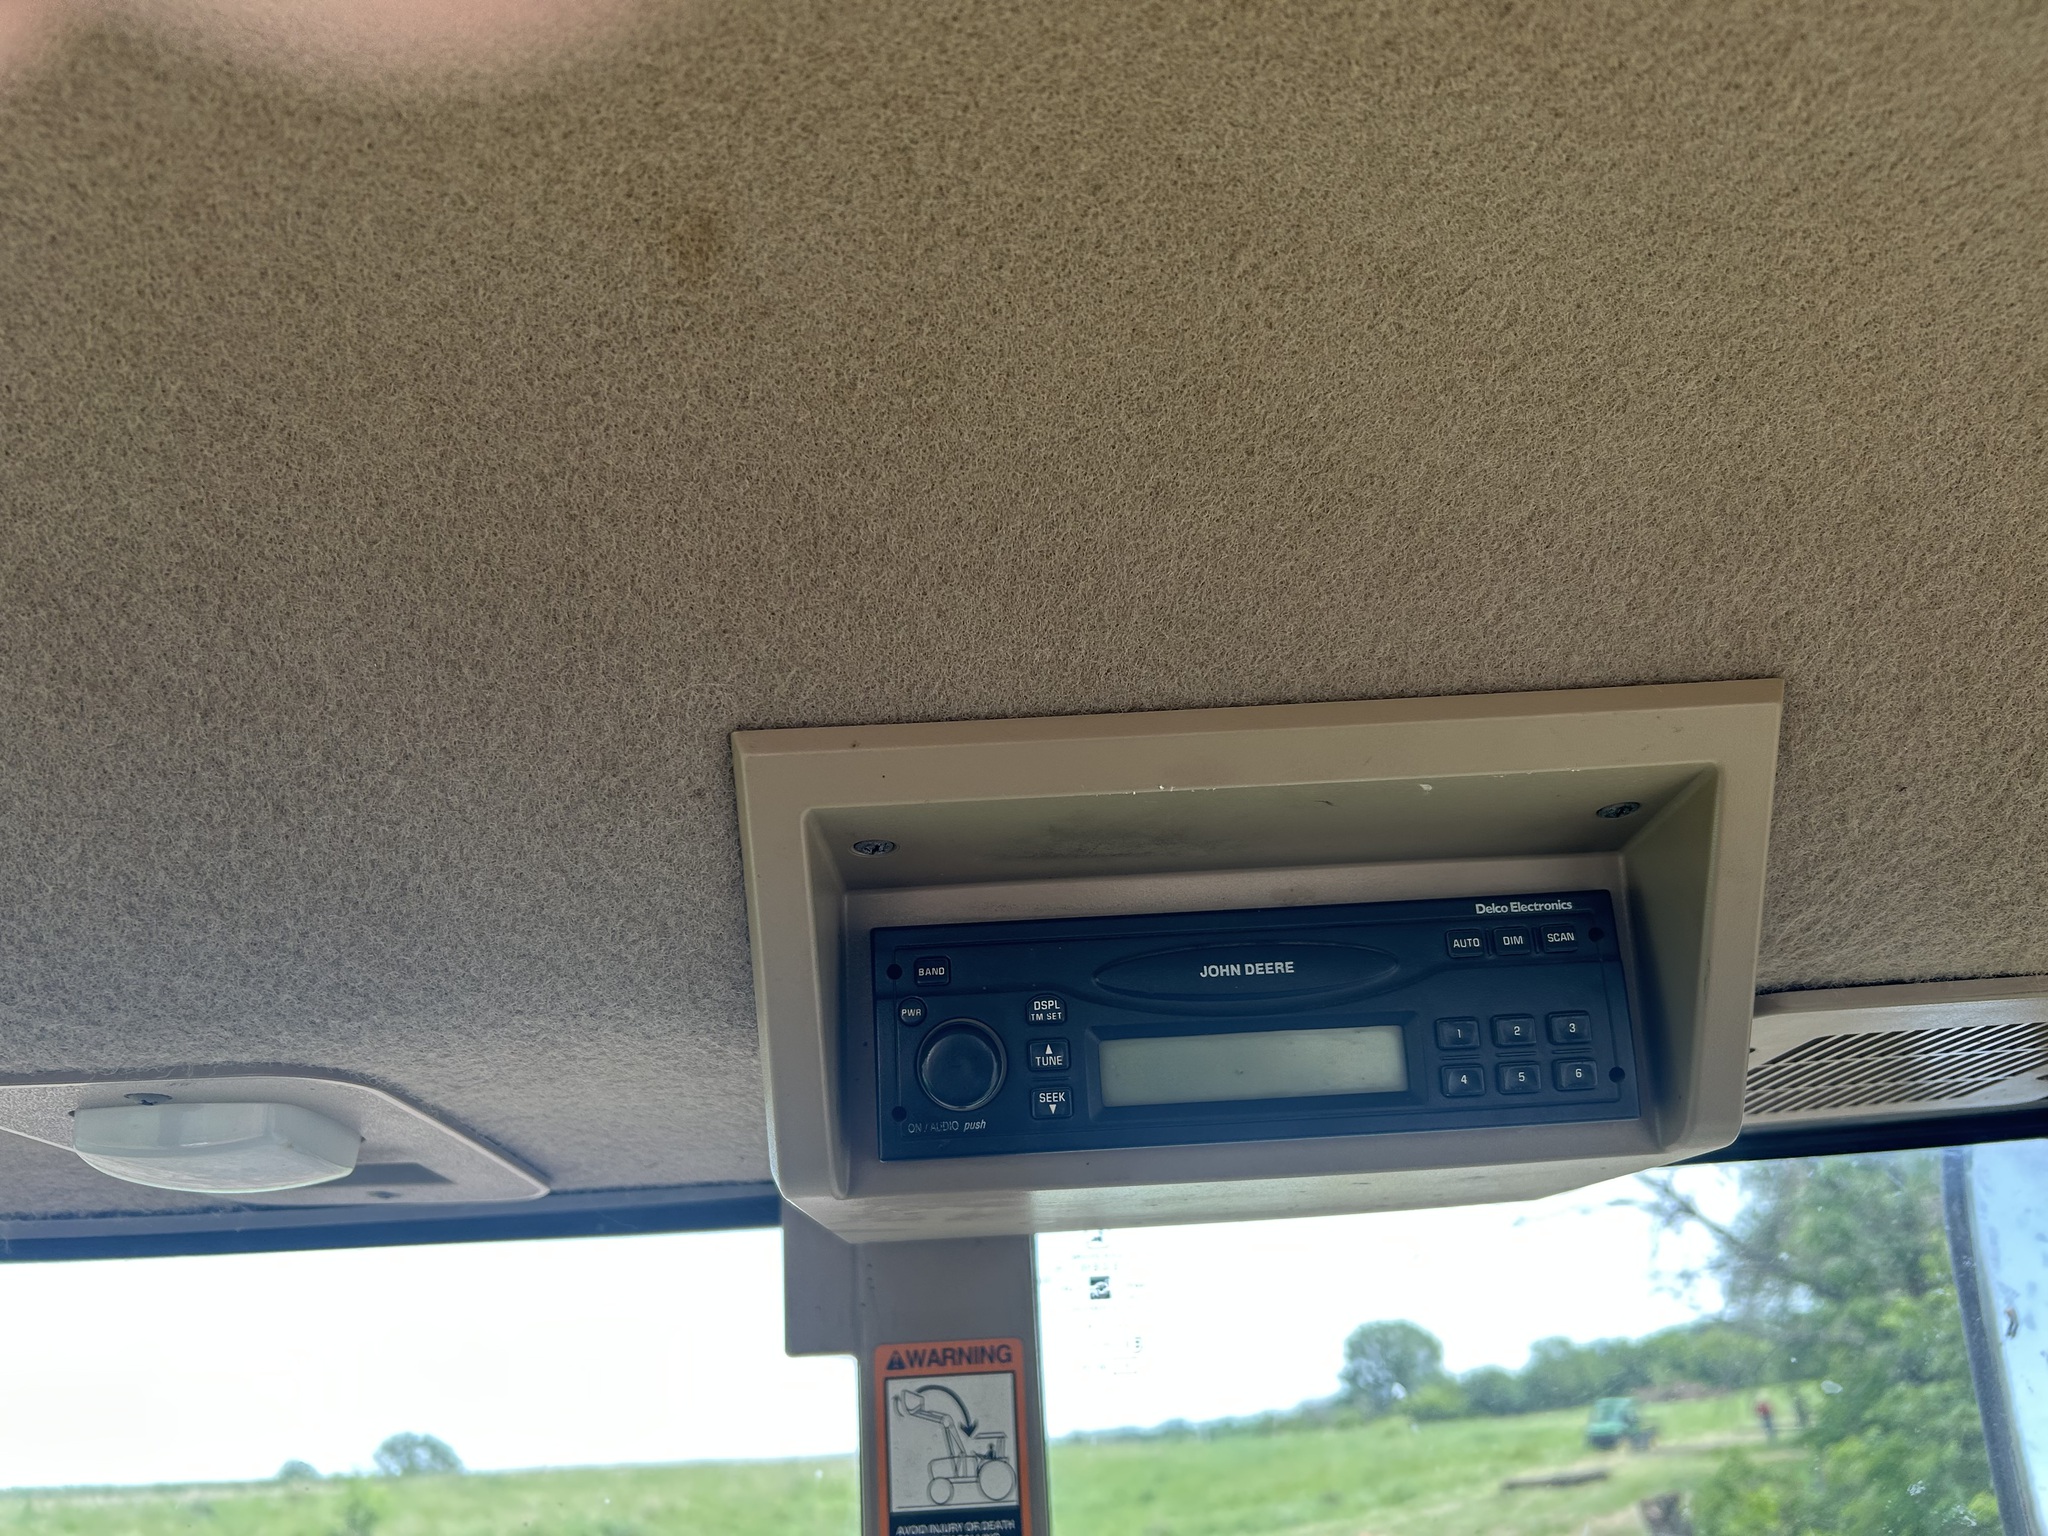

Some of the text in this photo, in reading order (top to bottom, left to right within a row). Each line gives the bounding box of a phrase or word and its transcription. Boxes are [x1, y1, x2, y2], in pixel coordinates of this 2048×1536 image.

[1475, 900, 1573, 914] Delco Electronics
[1453, 938, 1480, 948] AUTO
[1503, 936, 1524, 946] DIM
[1547, 933, 1575, 943] SCAN
[918, 967, 945, 976] BAND
[1200, 961, 1295, 978] JOHN DEERE
[1033, 1000, 1061, 1011] DSPL
[901, 1008, 922, 1017] PWR
[1030, 1012, 1062, 1021] TM SET
[1513, 1026, 1520, 1036] 2
[1568, 1023, 1576, 1033] 3
[1457, 1029, 1461, 1038] 1
[1035, 1055, 1063, 1067] TUNE
[1518, 1072, 1526, 1082] 5
[1575, 1068, 1583, 1078] 6
[1460, 1074, 1468, 1084] 4
[1039, 1092, 1066, 1103] SEEK
[963, 1119, 987, 1133] push
[906, 1344, 1013, 1368] WARNING
[896, 1524, 928, 1535] AVOID
[929, 1521, 963, 1534] INJURY
[983, 1519, 1016, 1531] DEATH
